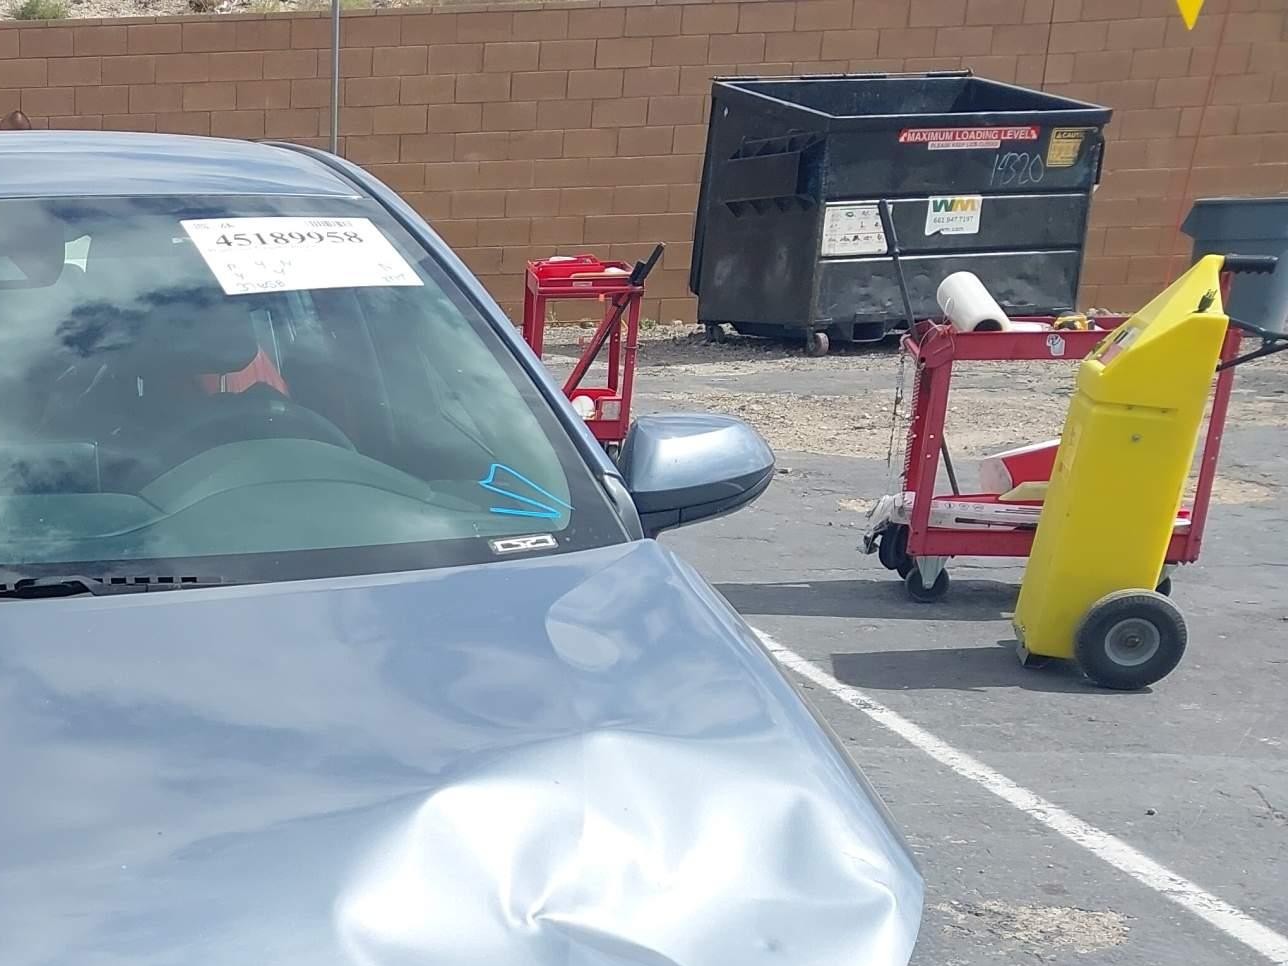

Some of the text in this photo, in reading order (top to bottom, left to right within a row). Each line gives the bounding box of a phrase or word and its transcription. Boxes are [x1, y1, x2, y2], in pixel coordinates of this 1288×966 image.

[907, 131, 953, 142] MAXIMUM
[955, 130, 999, 141] LOADING
[932, 198, 978, 213] WM
[215, 230, 364, 248] 45189958
